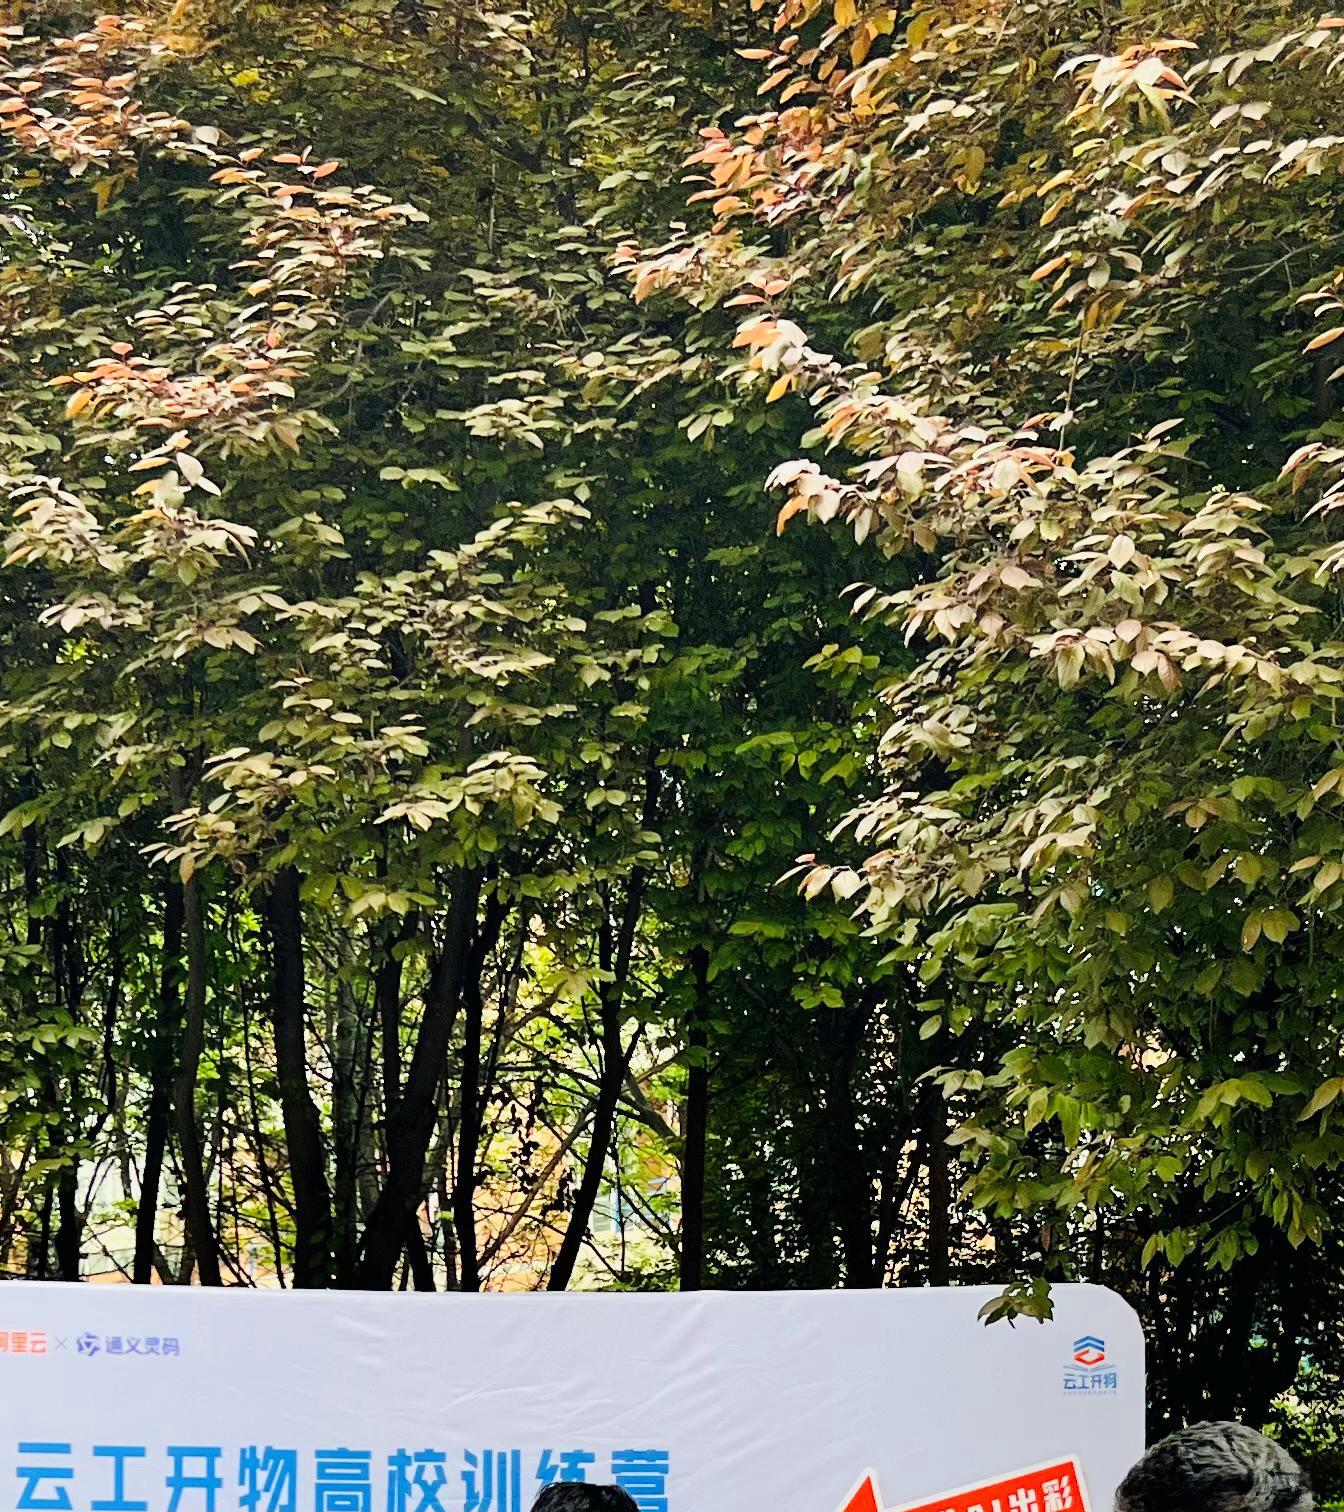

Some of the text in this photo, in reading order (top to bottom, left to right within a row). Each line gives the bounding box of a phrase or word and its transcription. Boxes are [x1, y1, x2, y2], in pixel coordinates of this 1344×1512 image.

[106, 1336, 180, 1357] 通义灵码
[1063, 1373, 1117, 1389] 云工开物
